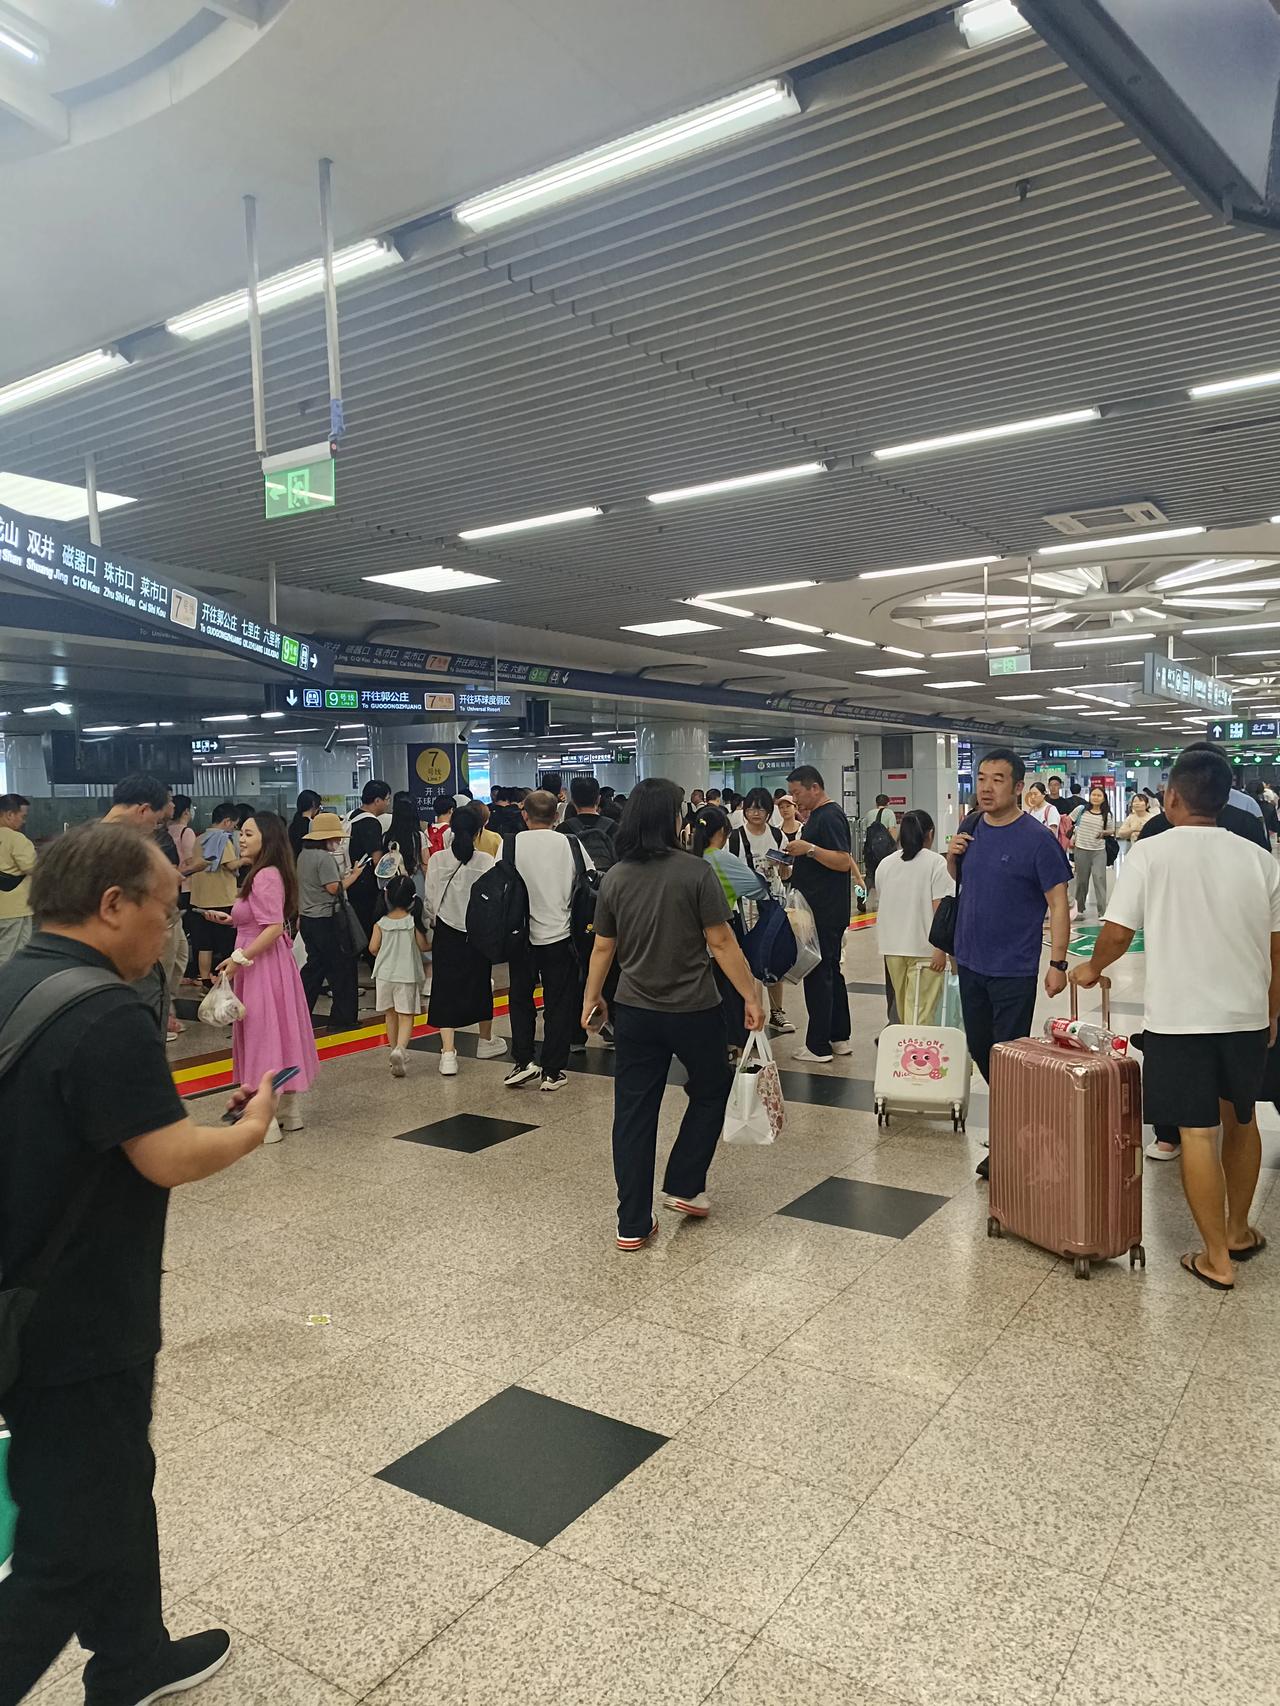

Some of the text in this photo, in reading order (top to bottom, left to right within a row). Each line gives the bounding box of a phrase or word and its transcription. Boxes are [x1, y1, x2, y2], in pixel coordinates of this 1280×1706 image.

[27, 529, 55, 560] 双井
[62, 544, 97, 576] 磁器口
[104, 561, 135, 591] 珠市口
[140, 576, 168, 604] 菜市口
[26, 557, 54, 580] Shuang
[54, 568, 69, 585] Jing
[72, 575, 80, 587] Ci
[80, 579, 87, 590] Qi
[87, 581, 100, 594] Kou
[103, 586, 114, 600] Zhu
[115, 590, 124, 603] Shi
[124, 593, 136, 607] Kou
[138, 599, 147, 612] Cai
[147, 602, 156, 615] Shi
[156, 606, 167, 619] Kou
[175, 594, 182, 619] 7
[200, 623, 206, 633] To
[201, 602, 281, 649] 开往郭公庄 七里庄 六里桥
[282, 640, 290, 660] 9
[430, 656, 438, 668] 7
[329, 692, 355, 706] 9 号线
[361, 690, 409, 702] 开往郭公庄
[429, 695, 436, 708] 7
[459, 694, 511, 705] 开往环球度假区
[1252, 723, 1275, 731] 北广场
[429, 751, 439, 767] 7
